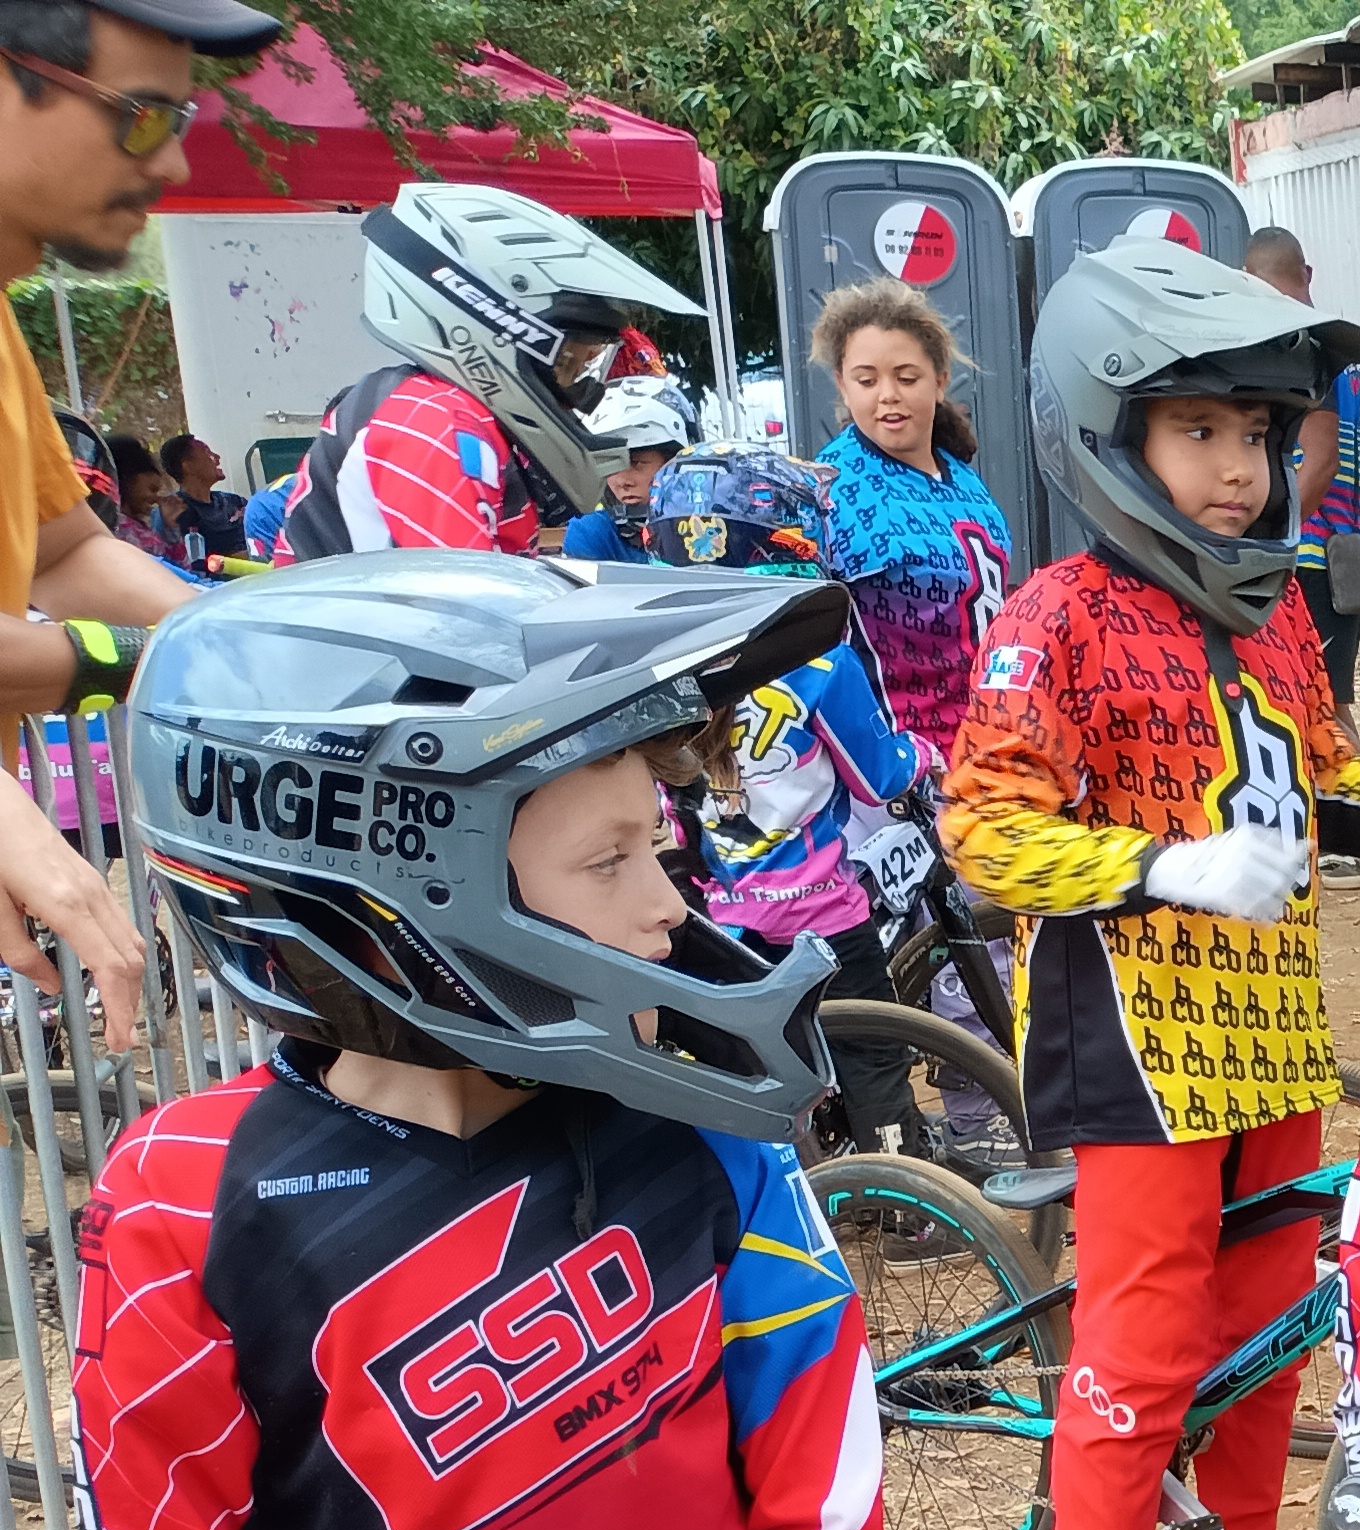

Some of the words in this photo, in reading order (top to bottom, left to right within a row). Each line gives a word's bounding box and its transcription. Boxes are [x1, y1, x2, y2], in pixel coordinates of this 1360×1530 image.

[175, 733, 365, 852] URGE
[372, 780, 456, 829] PRO
[368, 819, 437, 863] CO.
[550, 1381, 626, 1447] BMX
[622, 1343, 668, 1398] 974
